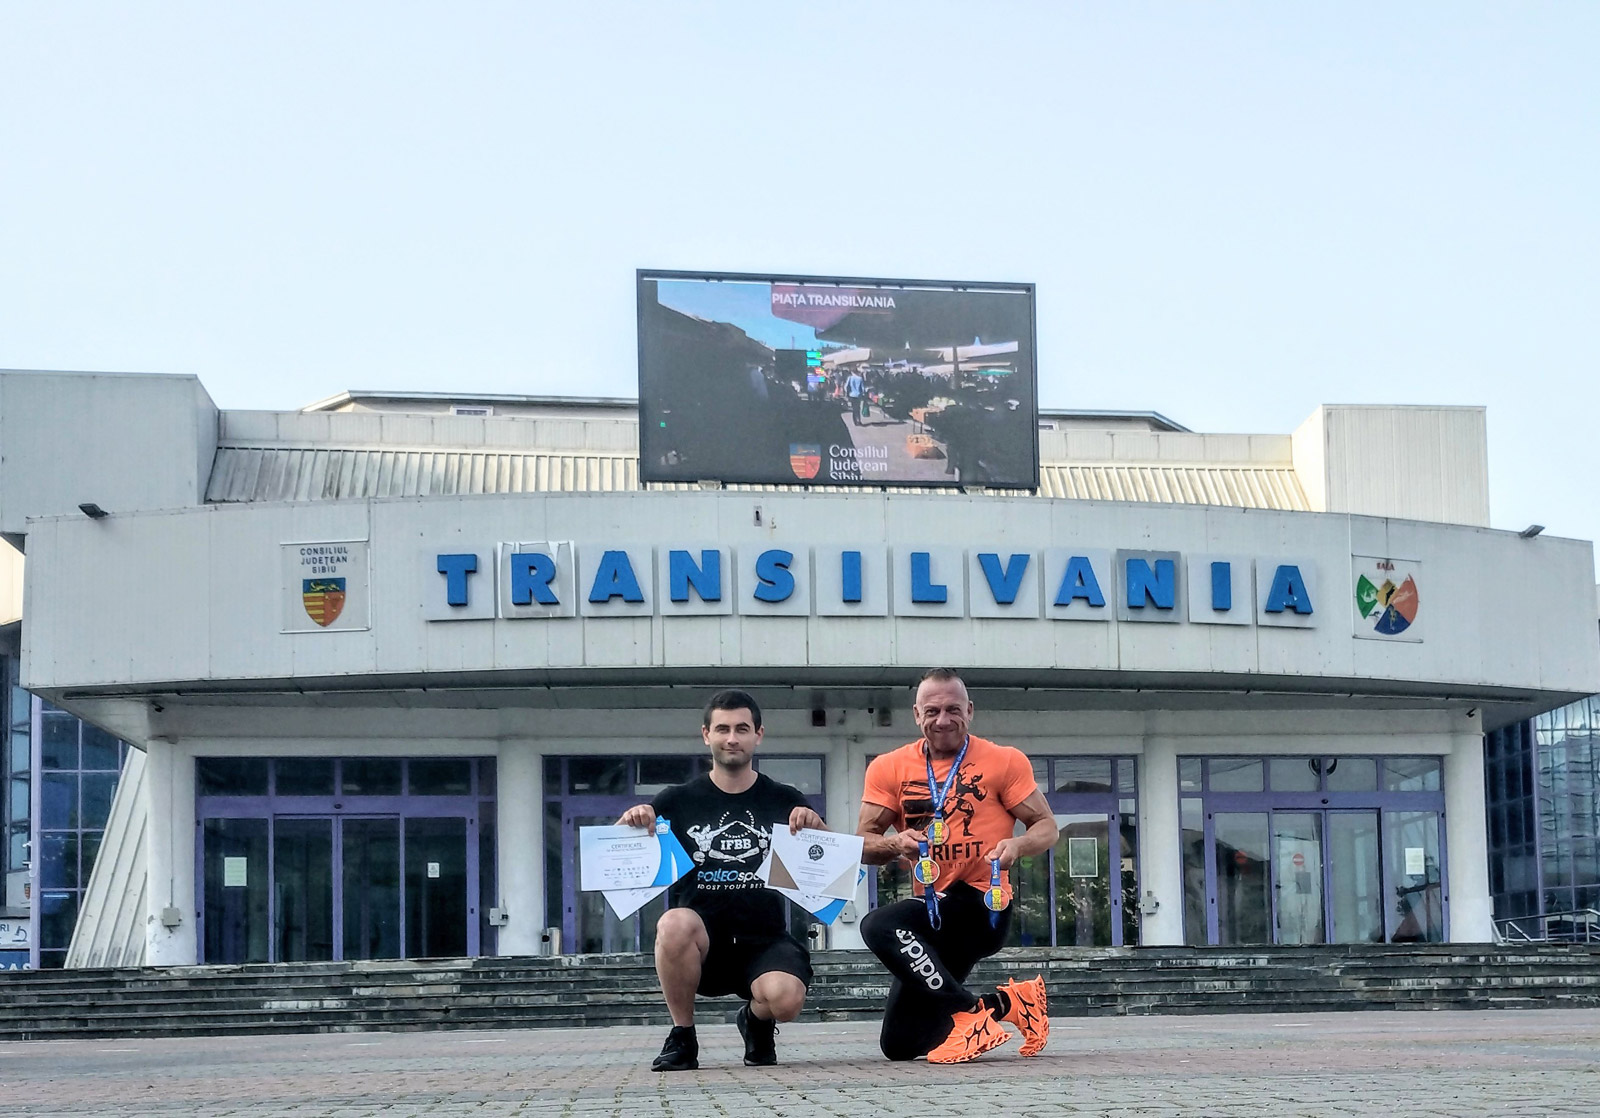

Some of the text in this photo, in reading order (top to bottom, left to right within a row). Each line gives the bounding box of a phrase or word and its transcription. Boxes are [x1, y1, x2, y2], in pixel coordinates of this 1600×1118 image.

[807, 294, 896, 308] TRANSILVANIA
[829, 444, 888, 459] Consiliul
[300, 546, 348, 556] CONSILIUL
[312, 566, 337, 574] SIBIU
[437, 549, 1314, 616] TRANSILVANIA
[720, 838, 752, 851] IFBB
[800, 832, 836, 844] CERTIFICATE
[931, 841, 983, 862] RIFIT
[895, 929, 944, 990] adidas
